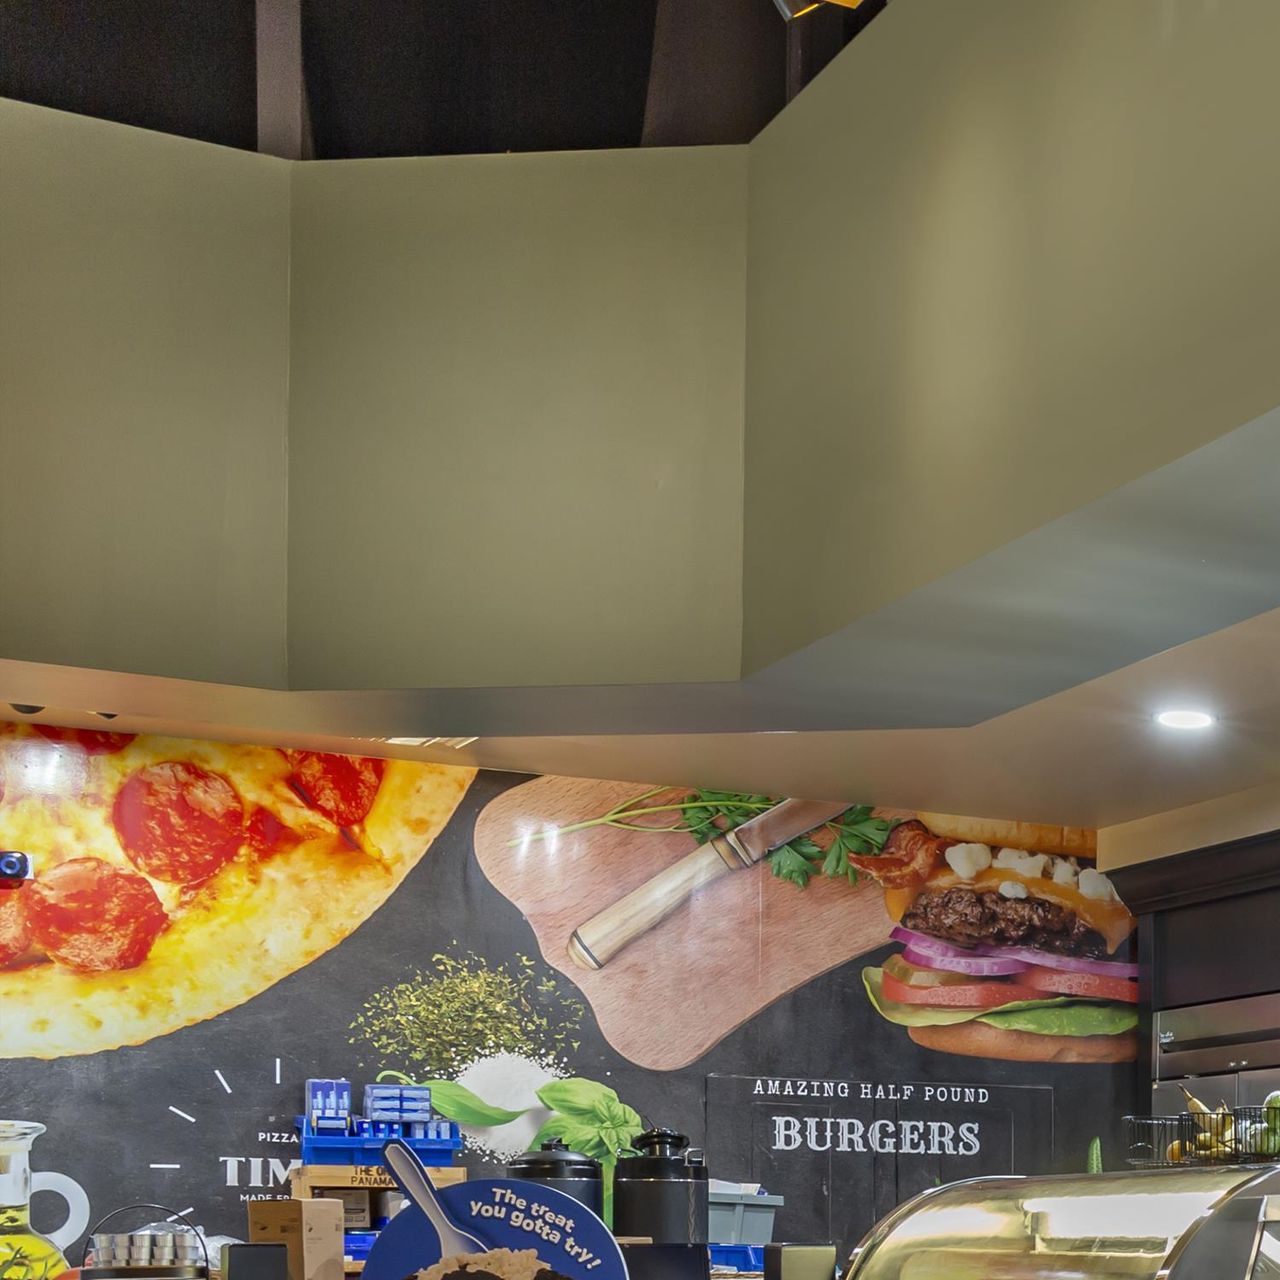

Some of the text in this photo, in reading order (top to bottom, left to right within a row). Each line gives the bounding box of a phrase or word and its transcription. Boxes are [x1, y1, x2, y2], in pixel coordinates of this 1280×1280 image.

[753, 1079, 990, 1104] AMAZING HALF POUND
[258, 1132, 299, 1144] PIZZA
[771, 1116, 981, 1156] BURGERS
[351, 1176, 394, 1187] PANAMA
[354, 1166, 375, 1176] THE
[491, 1187, 576, 1233] The treat
[470, 1200, 602, 1270] you gotta try!
